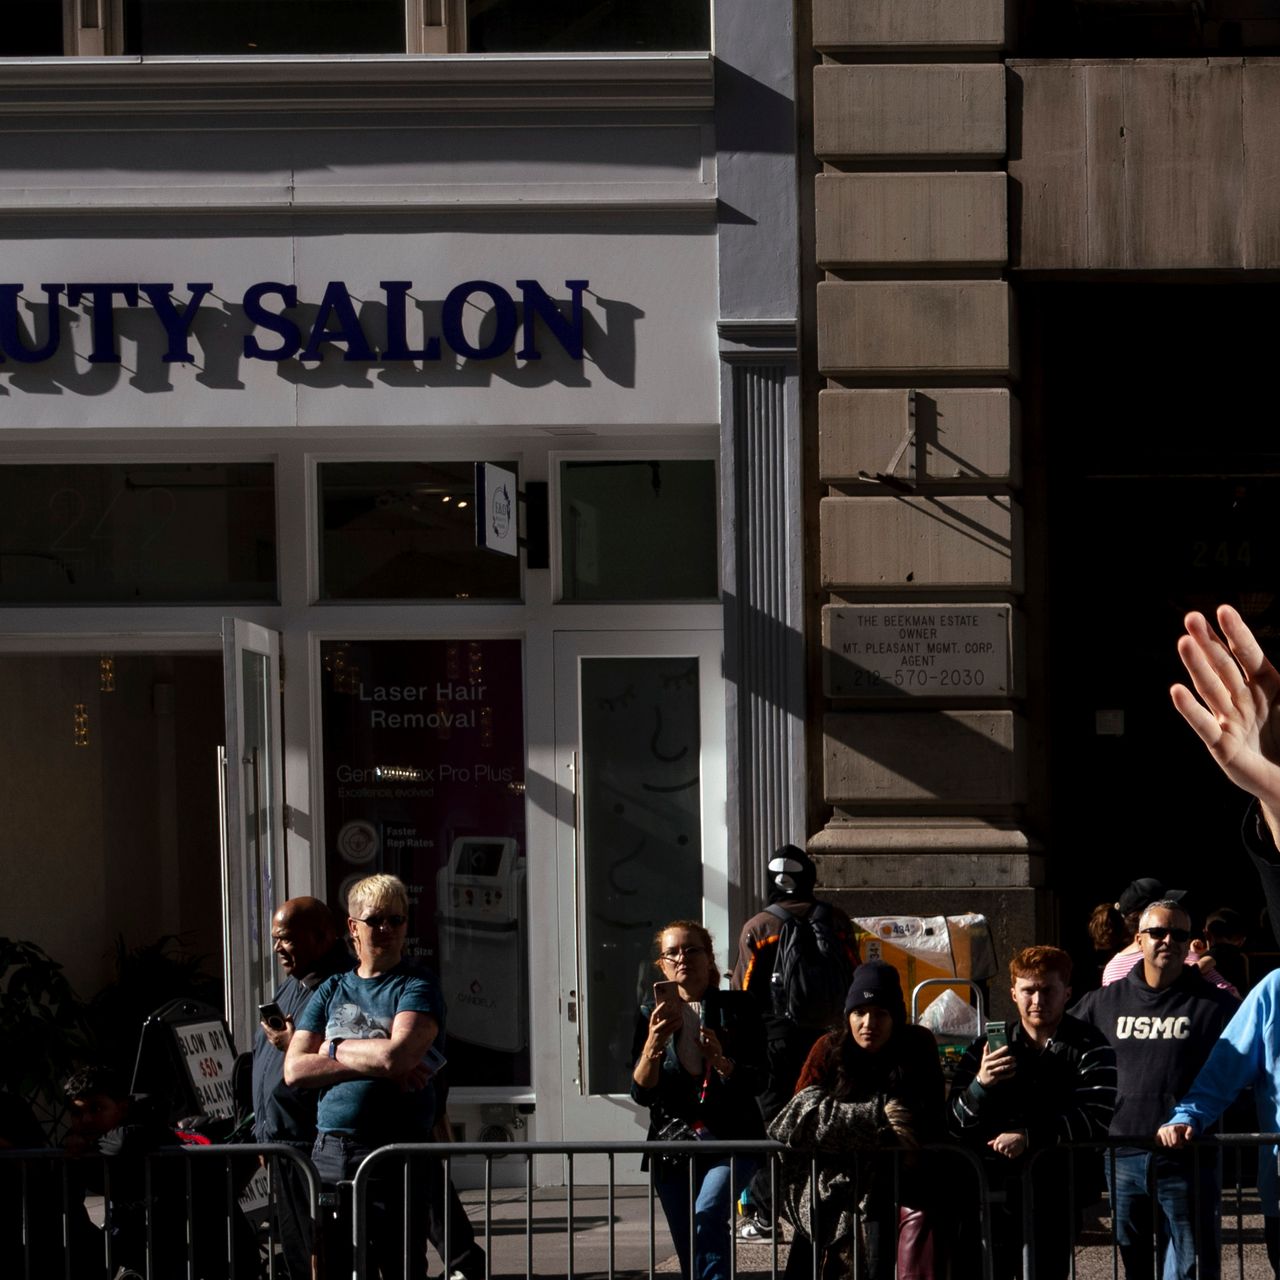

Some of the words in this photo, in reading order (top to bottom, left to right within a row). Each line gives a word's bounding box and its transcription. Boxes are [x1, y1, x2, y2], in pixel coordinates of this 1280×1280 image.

[0, 283, 213, 363] UTY
[242, 280, 589, 362] SALON
[858, 615, 879, 627] THE
[884, 615, 935, 627] BEEKMAN
[940, 615, 979, 627] ESTATE
[899, 628, 938, 639] OWNER
[842, 643, 862, 654] MT.
[866, 643, 920, 654] PLEASANT
[927, 643, 961, 654] MGMT.
[965, 643, 995, 654] CORP.
[900, 655, 936, 667] AGENT
[854, 669, 985, 686] 212-570-2030
[359, 682, 428, 702] Laser
[436, 682, 487, 702] Hair
[370, 709, 476, 728] Removal
[439, 764, 470, 782] Pro
[474, 764, 513, 782] Plus
[386, 826, 417, 837] Faster
[407, 838, 435, 848] Rates
[1116, 1016, 1191, 1039] USMC
